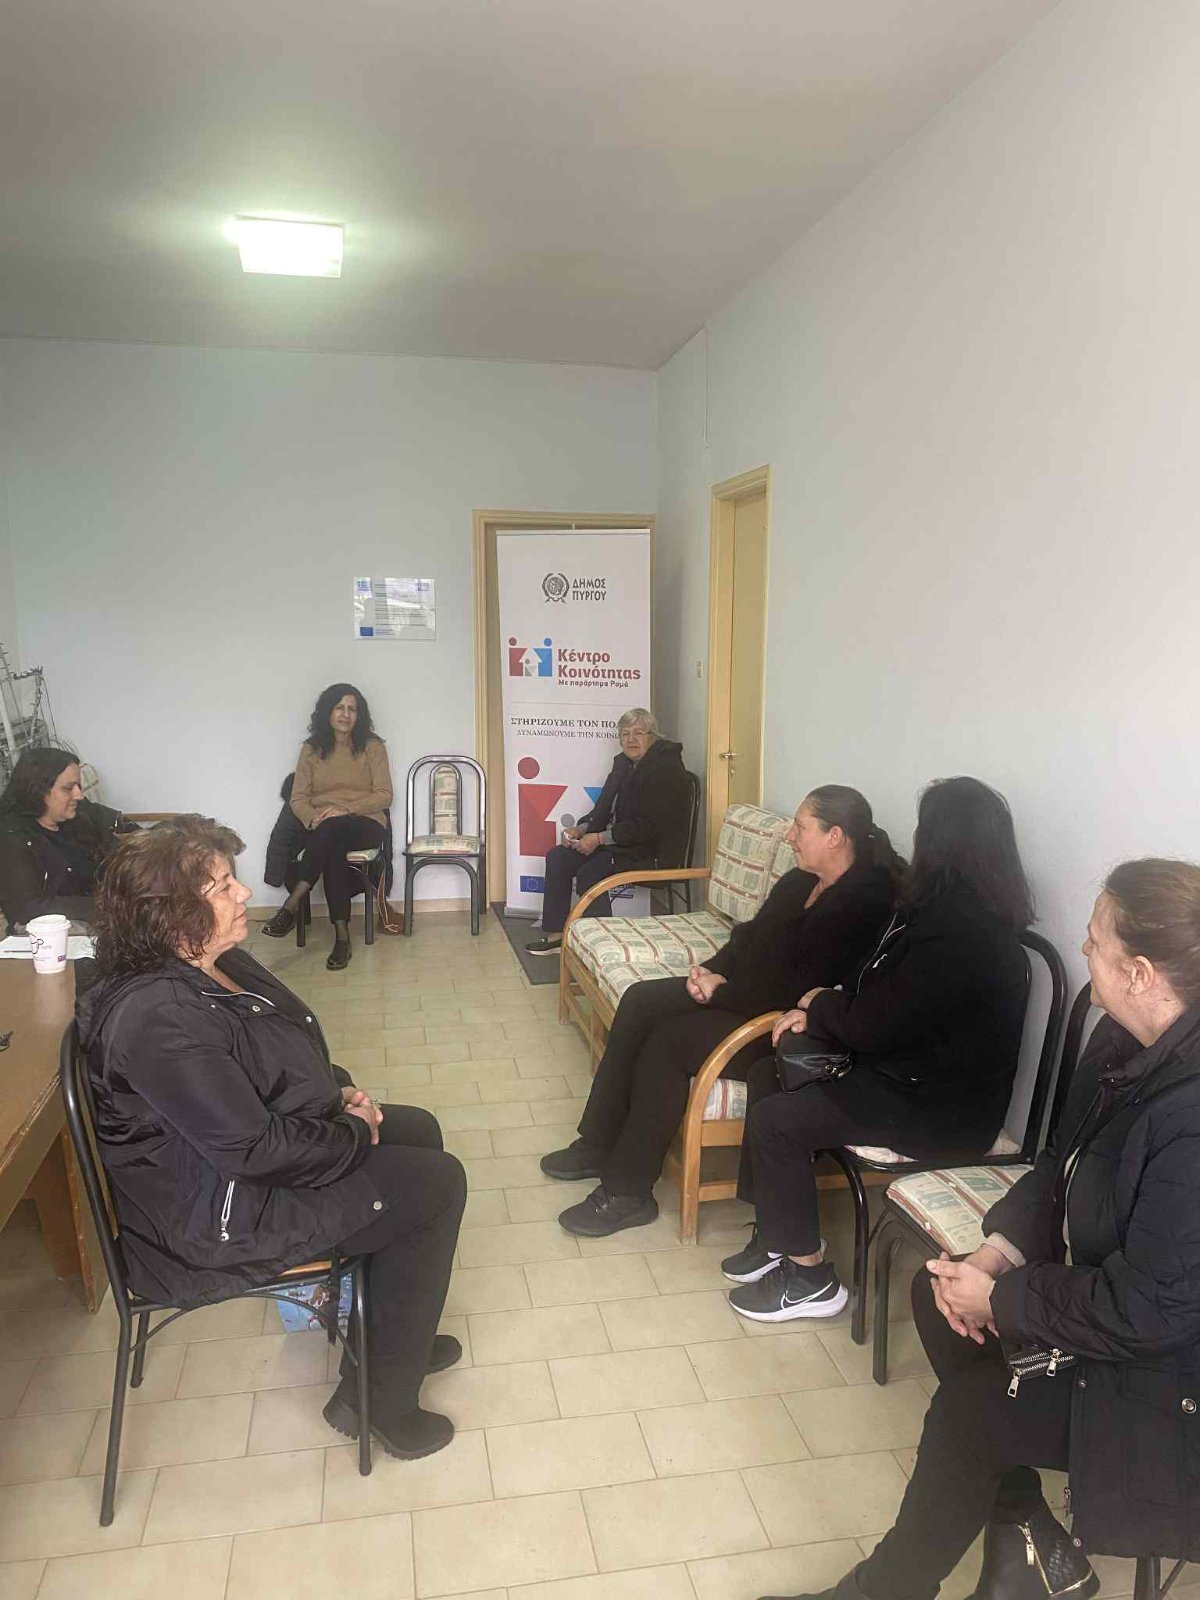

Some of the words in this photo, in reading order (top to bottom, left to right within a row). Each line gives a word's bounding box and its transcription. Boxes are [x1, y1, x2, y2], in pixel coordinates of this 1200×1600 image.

[572, 578, 606, 589] ΔΗΜΟΣ
[572, 590, 607, 601] ΠΥΡΓΟΥ
[558, 648, 610, 665] Κέντρο
[558, 665, 641, 680] Κοινότητας
[510, 717, 575, 727] ΣΤΗΡΙΖΟΥΜΕ
[577, 719, 600, 728] ΤΟΝ
[576, 731, 594, 739] ΤΗΝ
